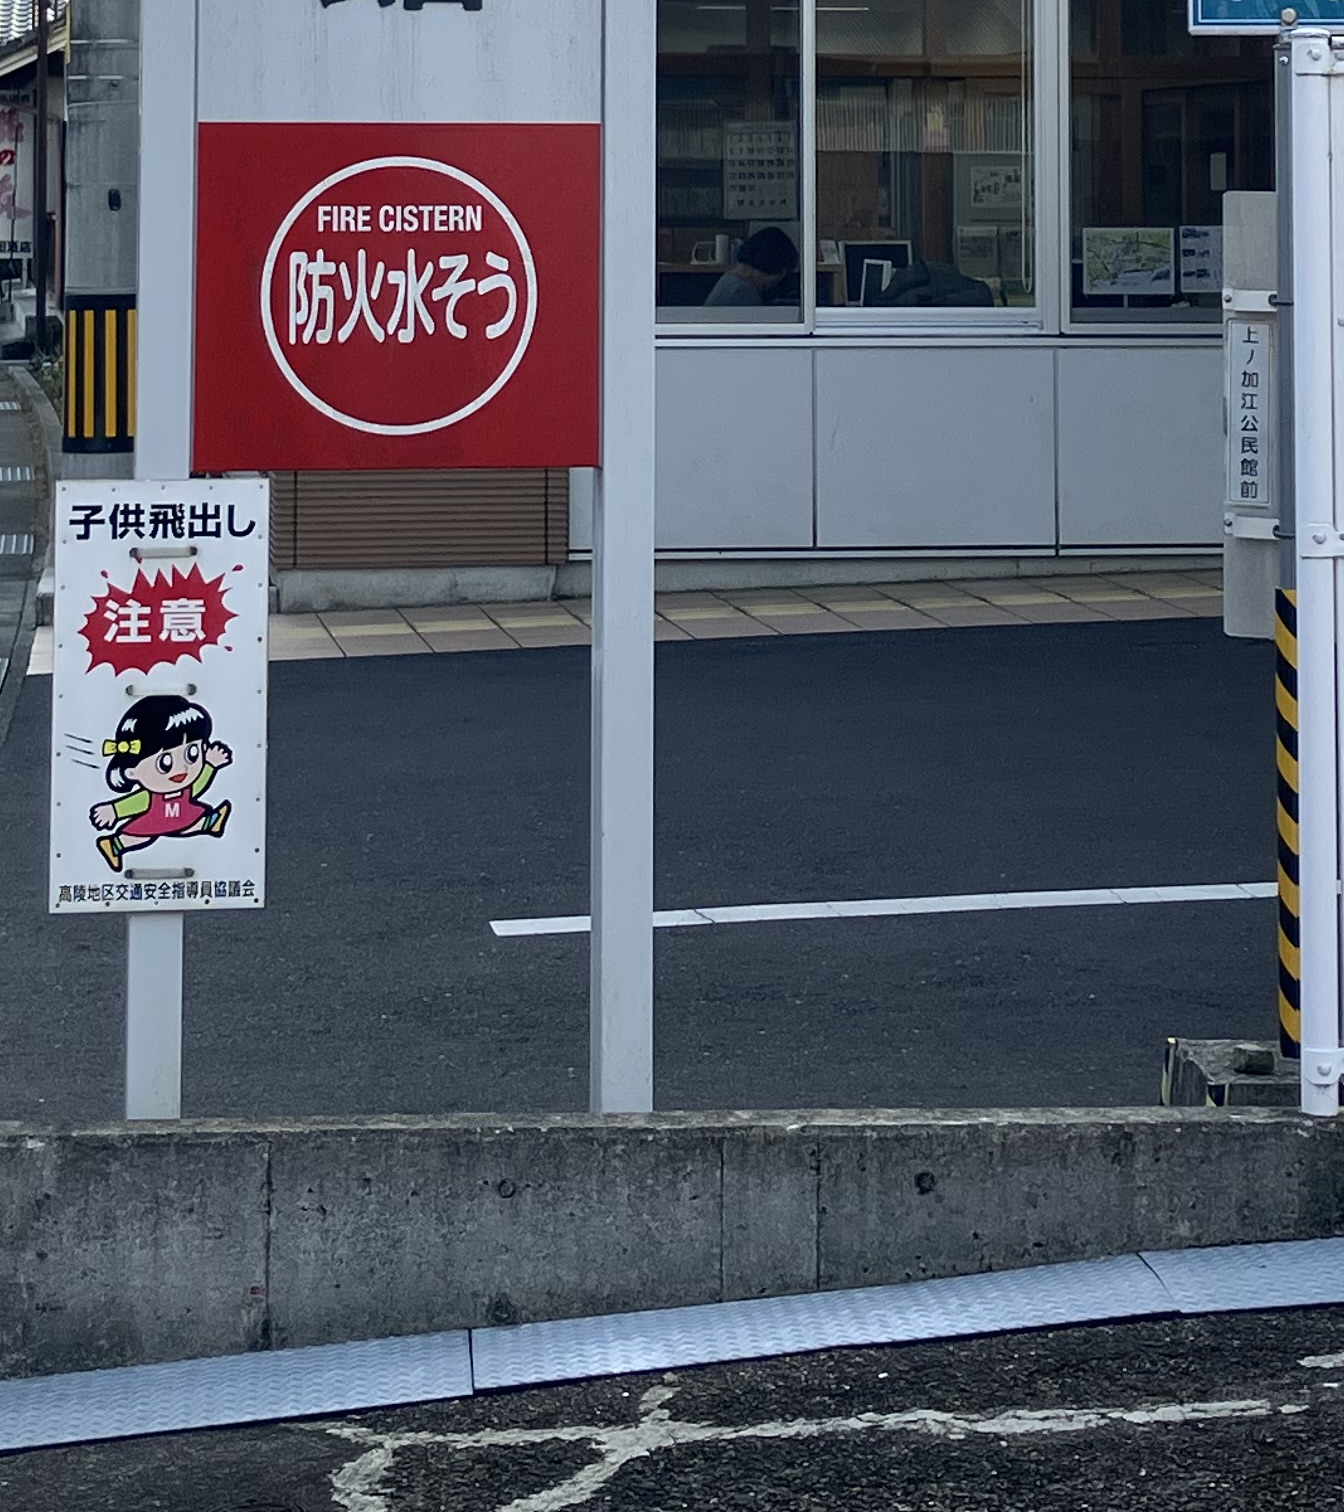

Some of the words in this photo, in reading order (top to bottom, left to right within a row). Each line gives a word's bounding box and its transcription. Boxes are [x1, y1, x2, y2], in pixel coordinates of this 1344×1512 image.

[317, 205, 372, 233] FIRE
[379, 204, 482, 233] CISTERN
[289, 248, 518, 346] 防火水そう
[1241, 326, 1259, 499] 上ノ加江公民館前
[69, 502, 256, 541] 子供飛出し
[103, 597, 207, 645] 注意
[165, 802, 180, 819] M
[58, 879, 256, 903] 高陵地区交通安全指導員協議会
